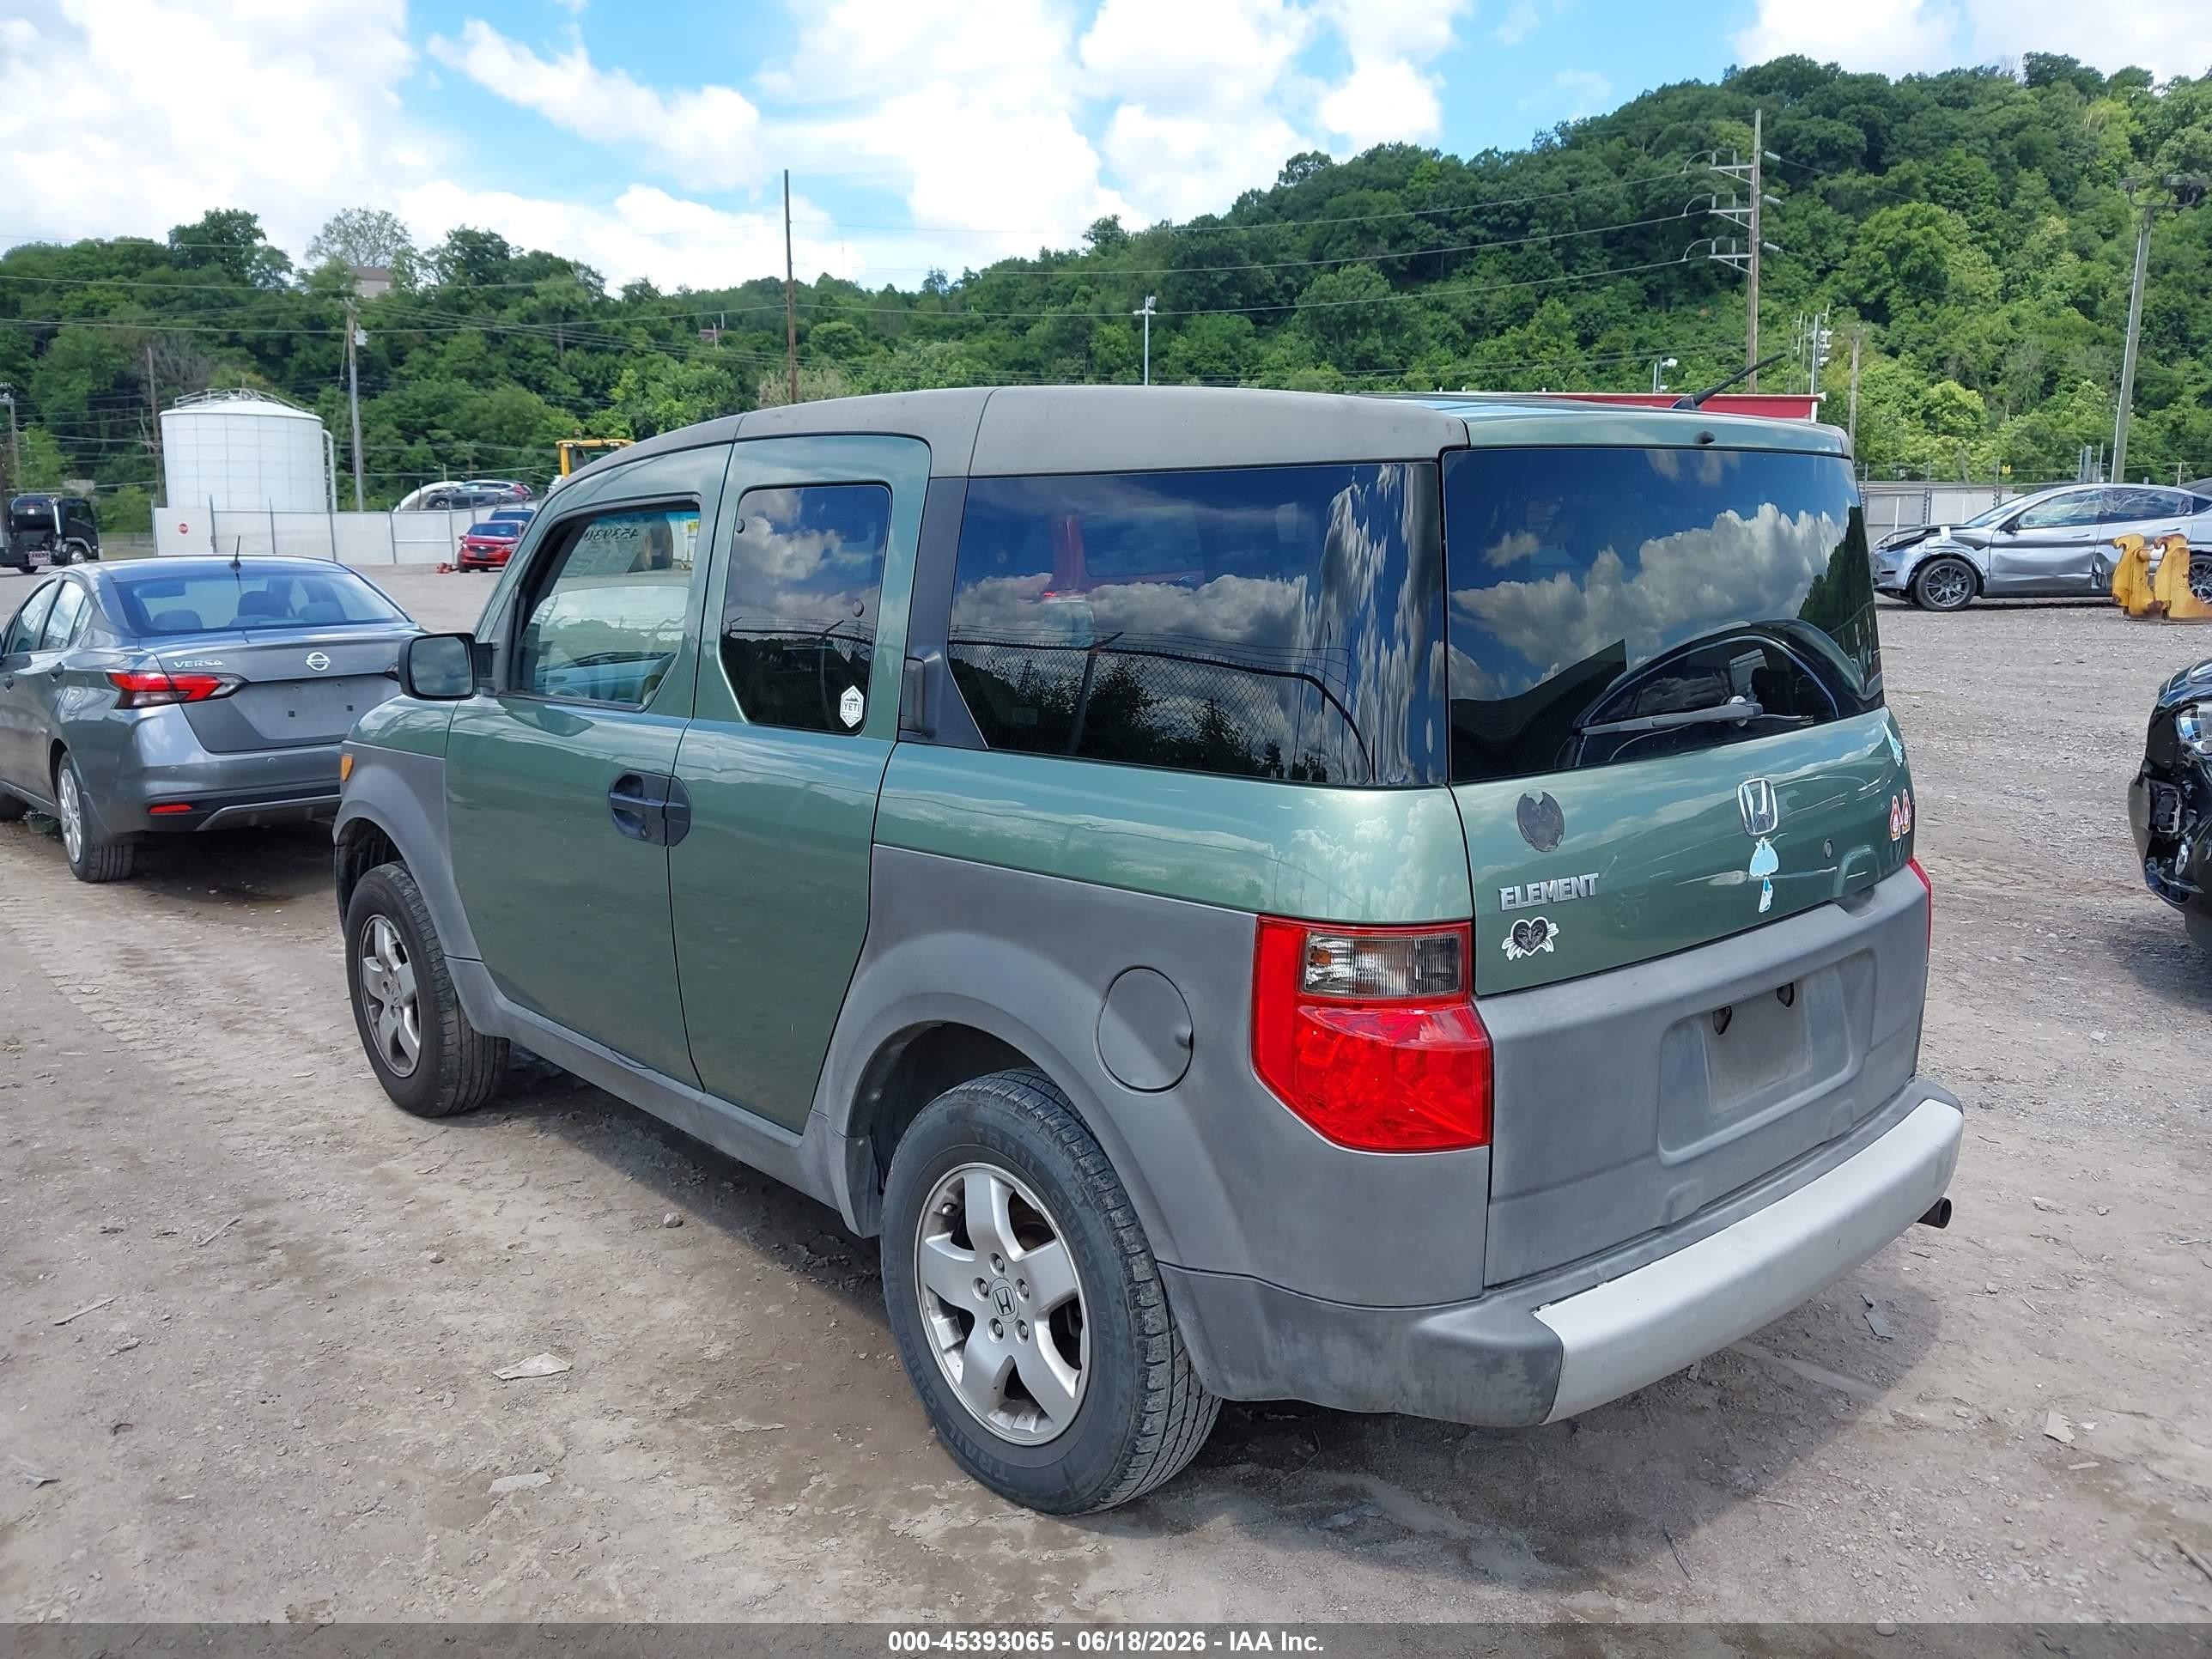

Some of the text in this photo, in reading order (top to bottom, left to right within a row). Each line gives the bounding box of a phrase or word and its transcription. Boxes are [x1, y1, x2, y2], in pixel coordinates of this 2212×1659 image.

[173, 659, 224, 668] VERSA
[843, 701, 860, 713] YETI
[1498, 872, 1599, 912] ELEMENT
[946, 1418, 1010, 1482] TRAIL
